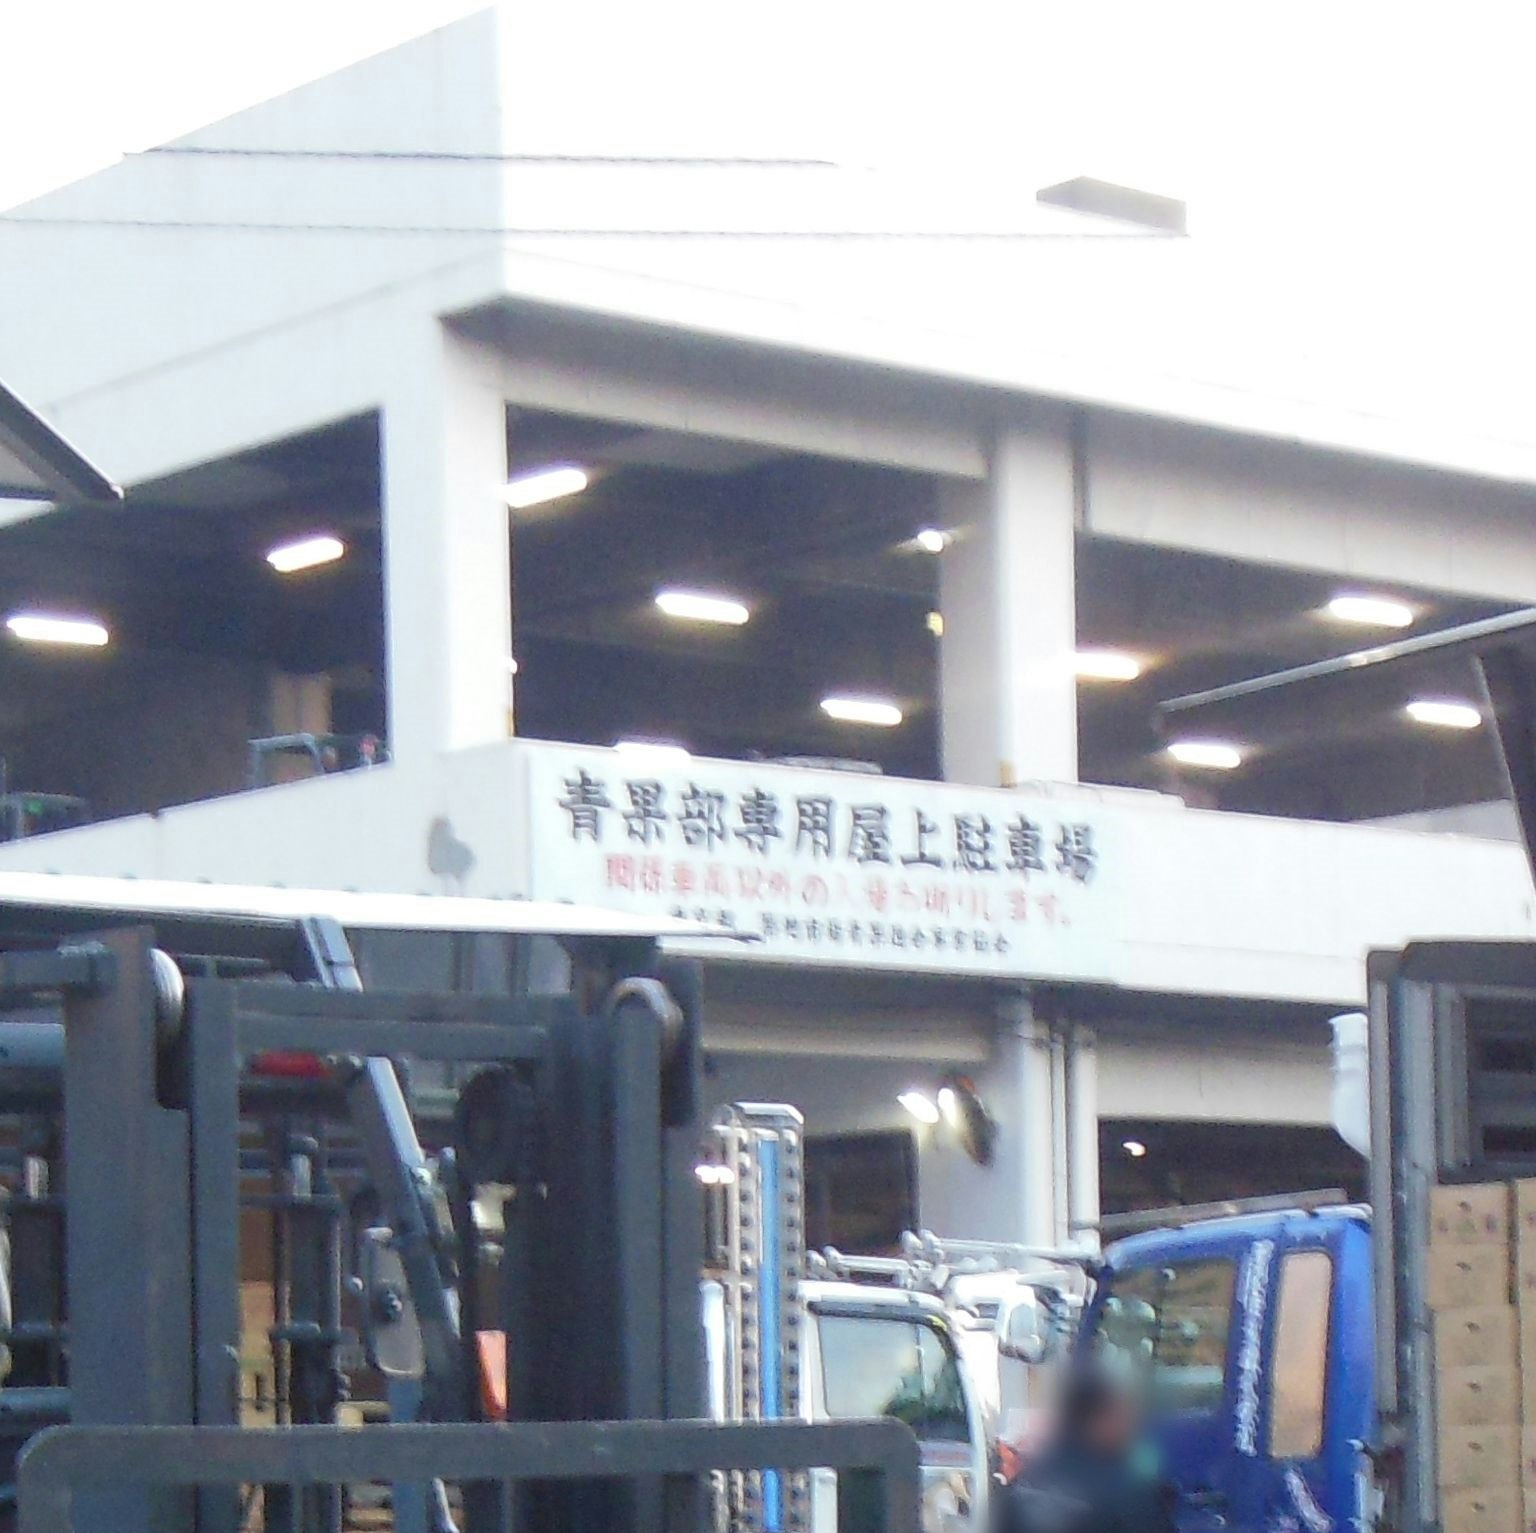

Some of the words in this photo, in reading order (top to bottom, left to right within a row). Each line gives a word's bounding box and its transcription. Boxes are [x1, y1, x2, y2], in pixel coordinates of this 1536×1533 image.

[559, 767, 1100, 885] 青果部専用屋上駐車場
